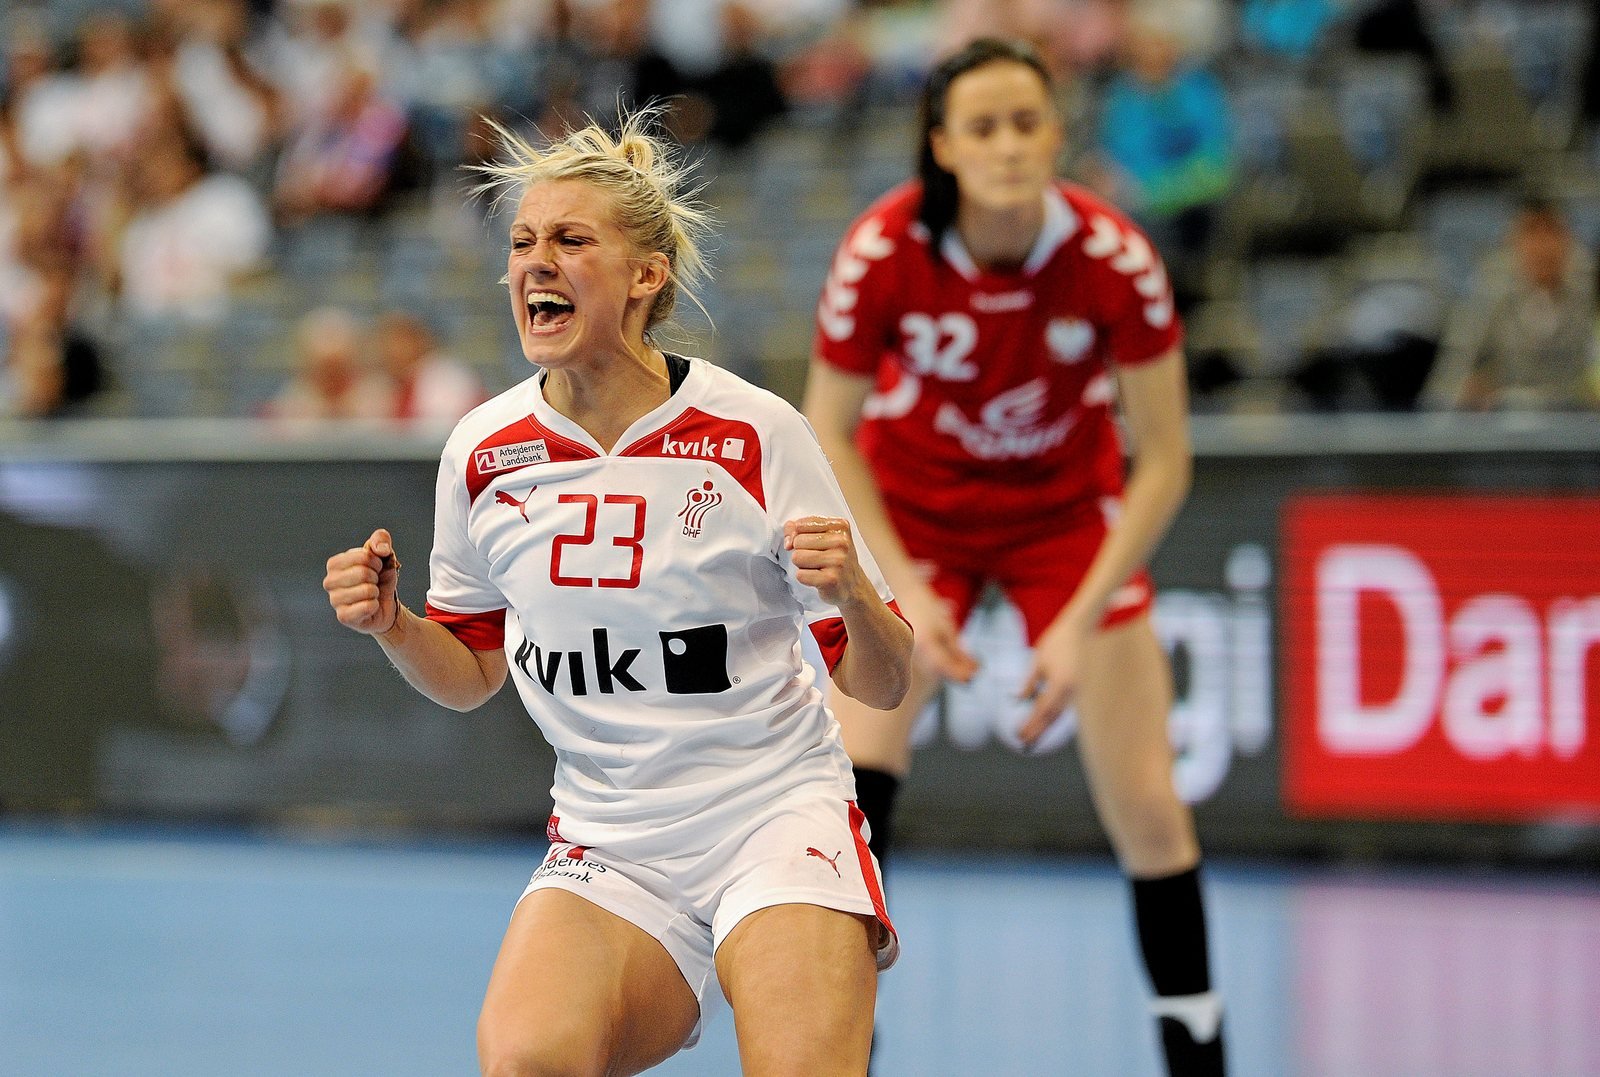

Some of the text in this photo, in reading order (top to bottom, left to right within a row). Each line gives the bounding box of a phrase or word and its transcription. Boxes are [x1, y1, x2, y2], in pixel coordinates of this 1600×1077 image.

[900, 312, 979, 381] 32
[499, 443, 545, 458] Arbejdernes
[661, 433, 717, 457] kvik
[501, 453, 543, 467] Landsbank
[549, 494, 647, 589] 23
[682, 526, 701, 539] DHF
[514, 627, 647, 696] kvik
